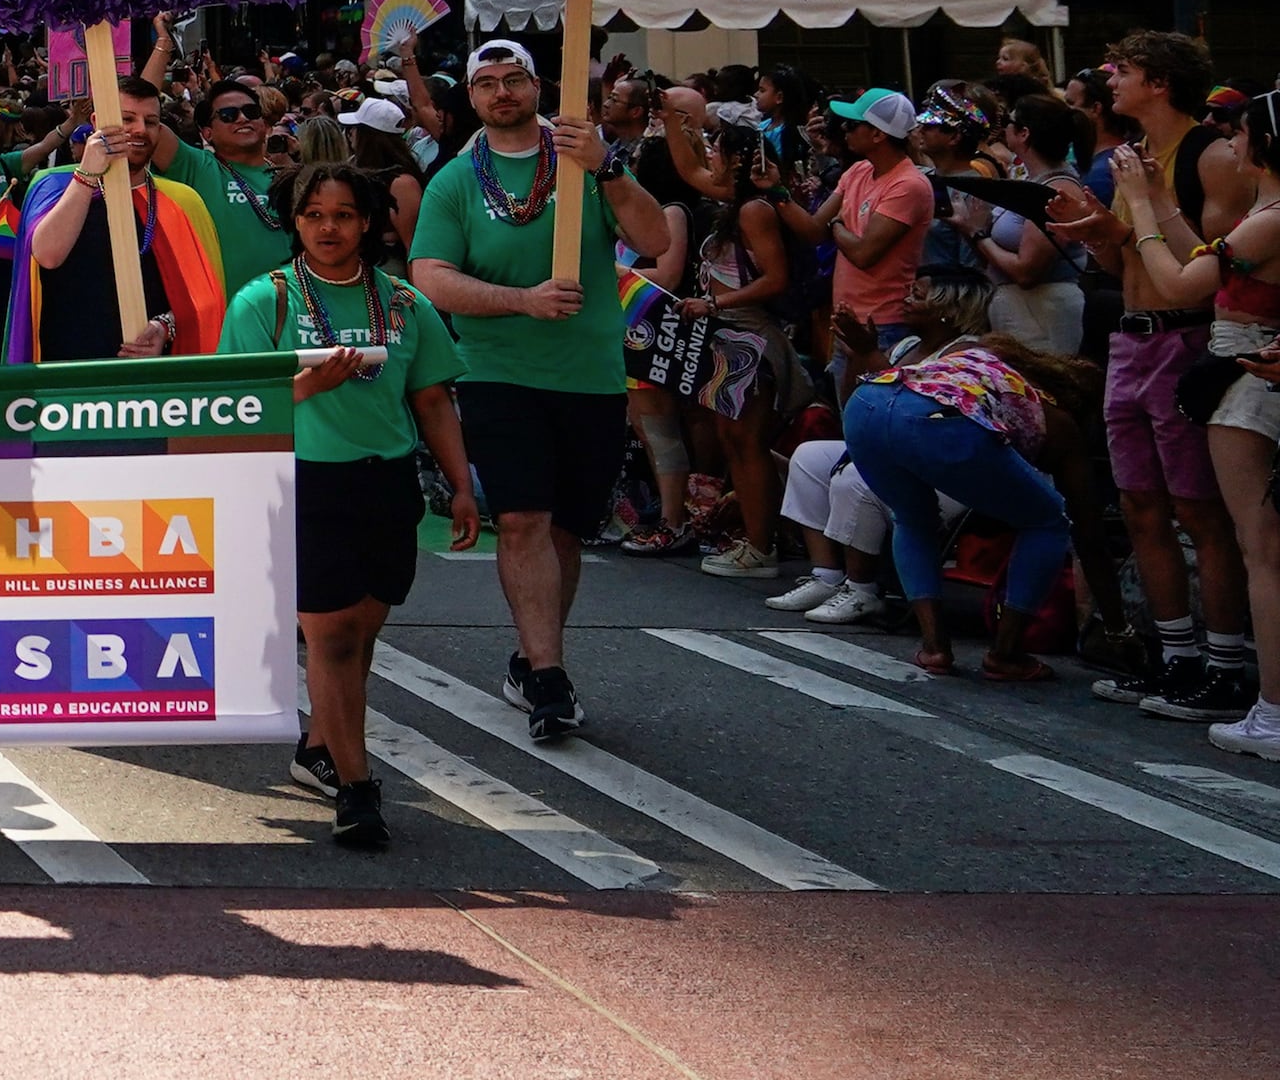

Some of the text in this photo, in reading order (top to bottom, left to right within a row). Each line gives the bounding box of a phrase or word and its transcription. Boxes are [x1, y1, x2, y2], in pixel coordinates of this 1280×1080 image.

[297, 328, 402, 346] TOETHR
[648, 304, 681, 385] BE GAY
[674, 339, 687, 362] AND
[678, 316, 709, 396] ORGANIZE
[5, 394, 263, 432] Commerce
[5, 579, 41, 592] HILL
[46, 578, 123, 591] BUSINESS
[129, 576, 208, 590] ALLIANCE
[52, 702, 63, 715] &
[68, 701, 161, 715] EDUCATION
[165, 700, 209, 713] FUND
